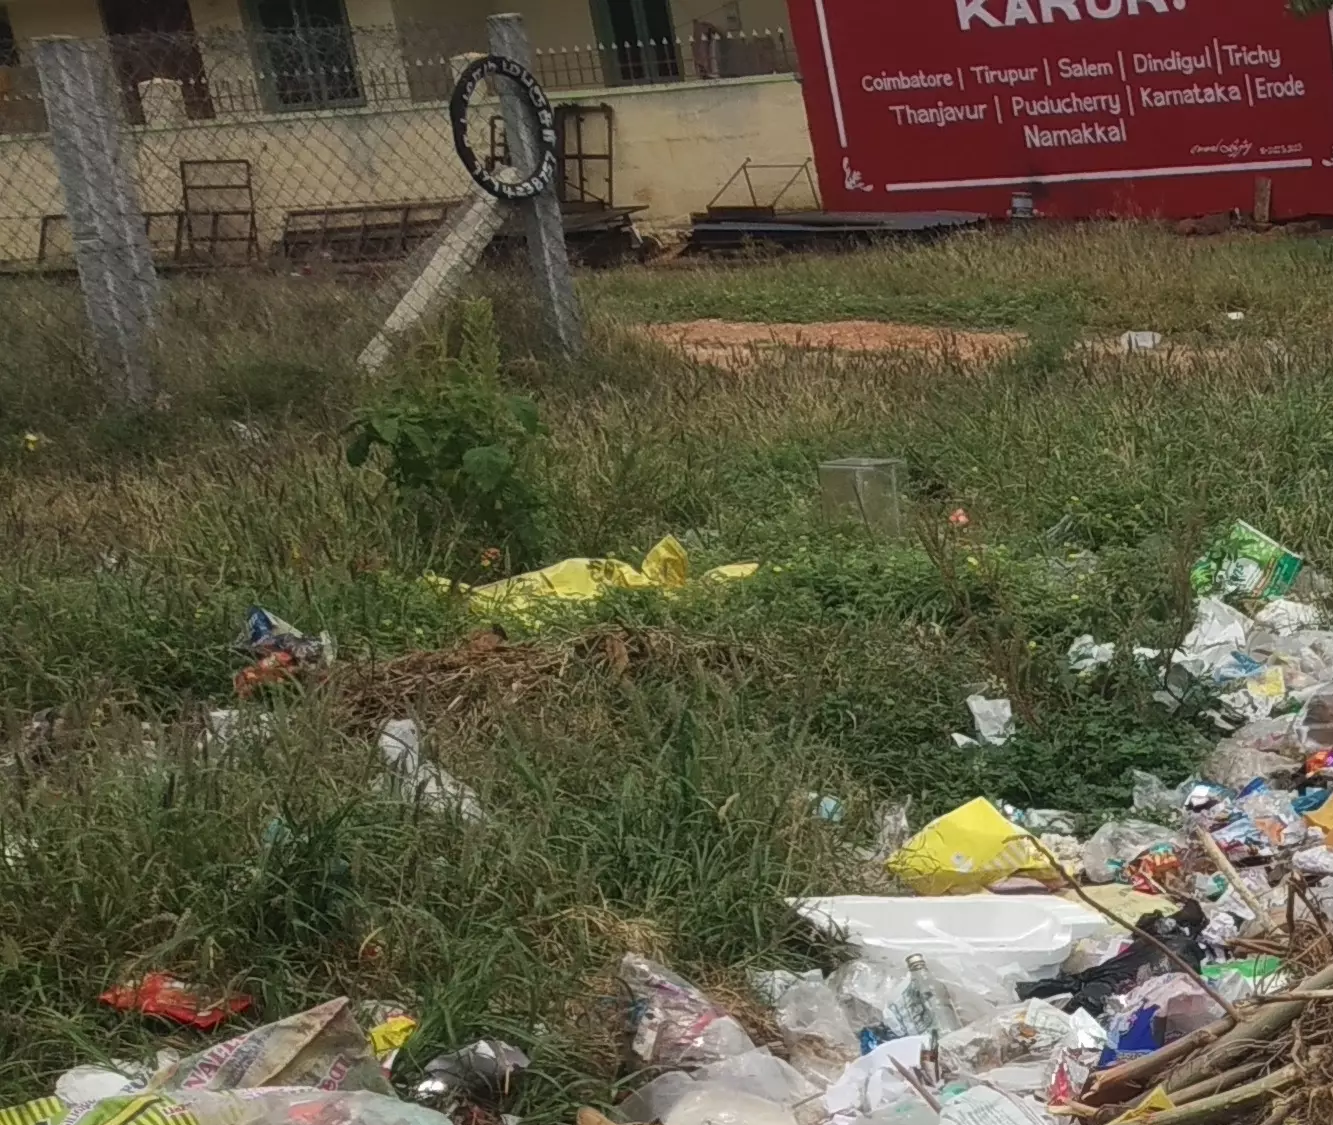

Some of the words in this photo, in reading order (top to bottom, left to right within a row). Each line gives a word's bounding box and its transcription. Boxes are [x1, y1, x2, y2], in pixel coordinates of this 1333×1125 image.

[861, 70, 953, 92] Coimbatore
[970, 65, 1038, 87] Tirupur
[1057, 57, 1114, 78] Salem
[1133, 45, 1212, 75] Dindigul
[1221, 44, 1281, 68] Trichy
[888, 100, 988, 127] Thanjavur
[1011, 92, 1121, 117] Puducherry
[1139, 82, 1242, 108] Karnataka
[1254, 73, 1306, 100] Erode
[1023, 117, 1127, 149] Namakkal
